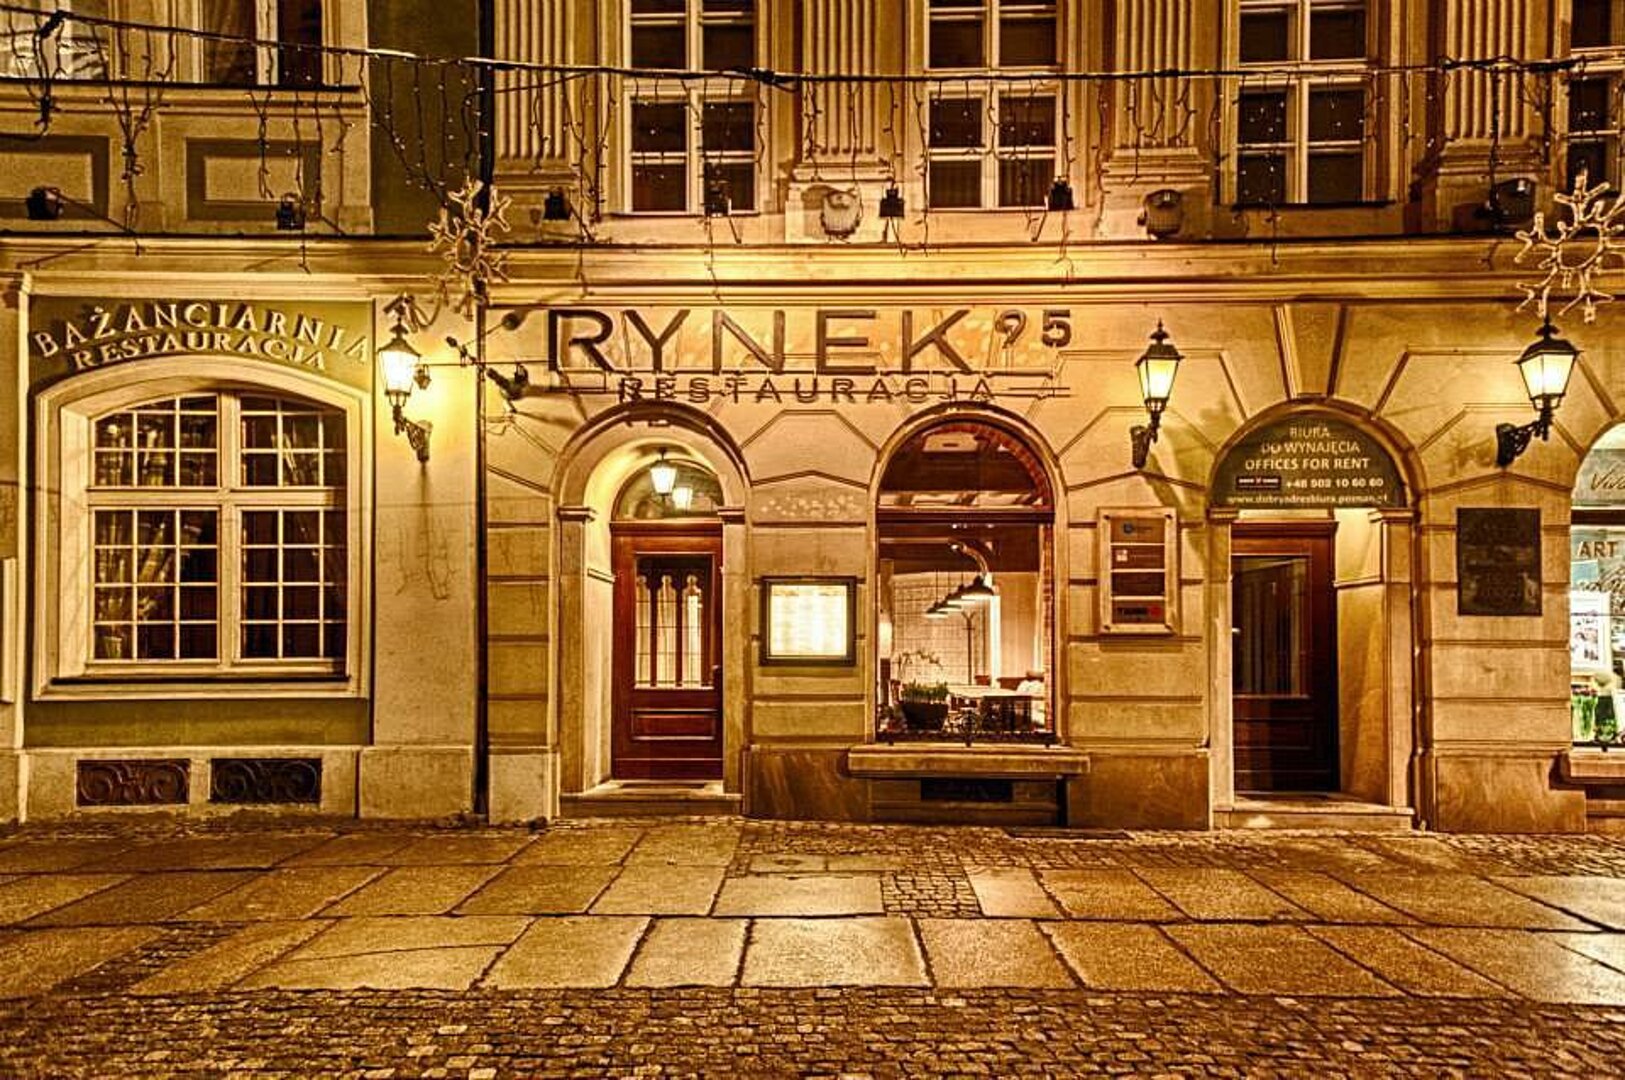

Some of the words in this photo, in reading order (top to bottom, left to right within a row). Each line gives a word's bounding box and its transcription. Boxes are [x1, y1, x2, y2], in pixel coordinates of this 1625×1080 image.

[34, 303, 371, 363] BAŻANCIARNIA
[548, 309, 973, 375] RYNEK
[995, 309, 1071, 349] 95
[72, 332, 326, 371] RESTAURACJA
[619, 377, 996, 404] RESTAURACJA
[1289, 427, 1330, 438] BIURA
[1262, 443, 1281, 454] DO
[1245, 459, 1299, 470] OFFICES
[1302, 458, 1330, 469] FOR
[1333, 457, 1371, 470] RENT
[1336, 478, 1350, 487] 10
[1579, 541, 1617, 558] ART
